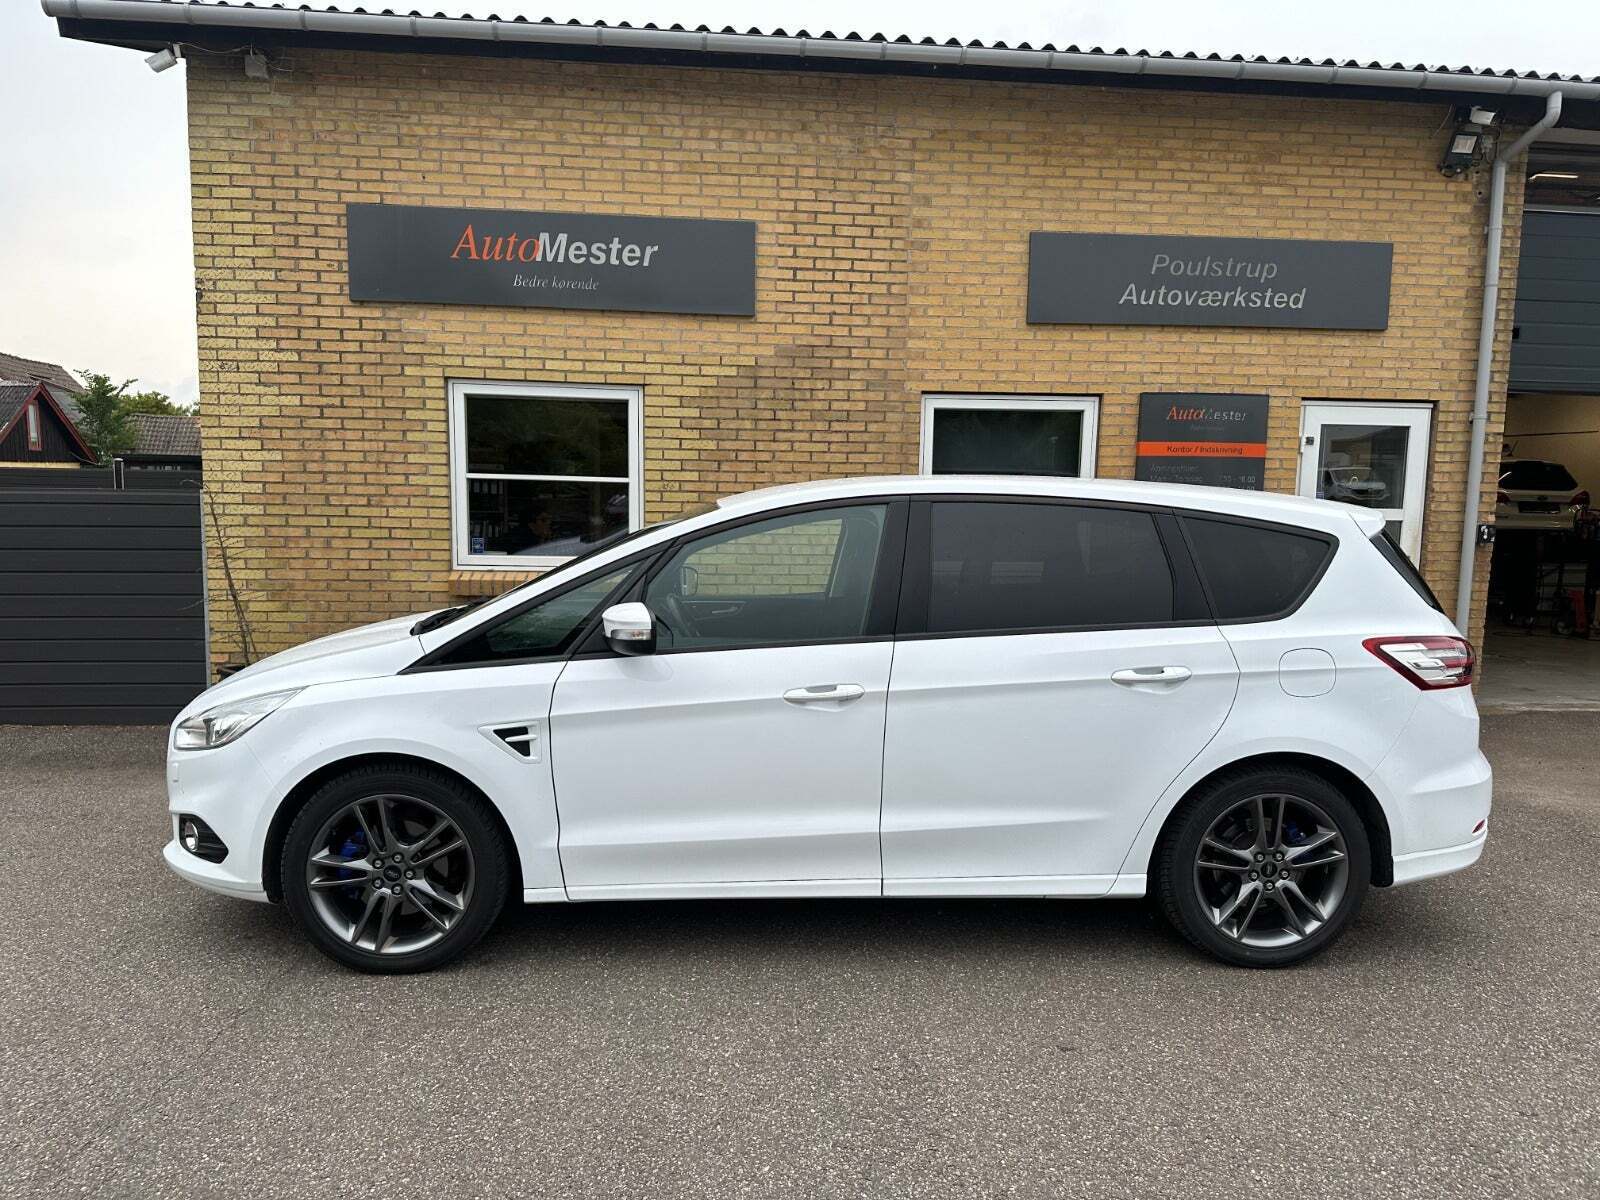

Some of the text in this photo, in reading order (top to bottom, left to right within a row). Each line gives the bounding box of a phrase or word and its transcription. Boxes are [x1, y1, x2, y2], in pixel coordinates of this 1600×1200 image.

[450, 223, 659, 267] AutoMester
[512, 273, 600, 291] Bedre kørende
[1151, 254, 1278, 284] Poulstrup
[1118, 283, 1307, 309] Autoværksted
[1167, 445, 1193, 453] Kontor
